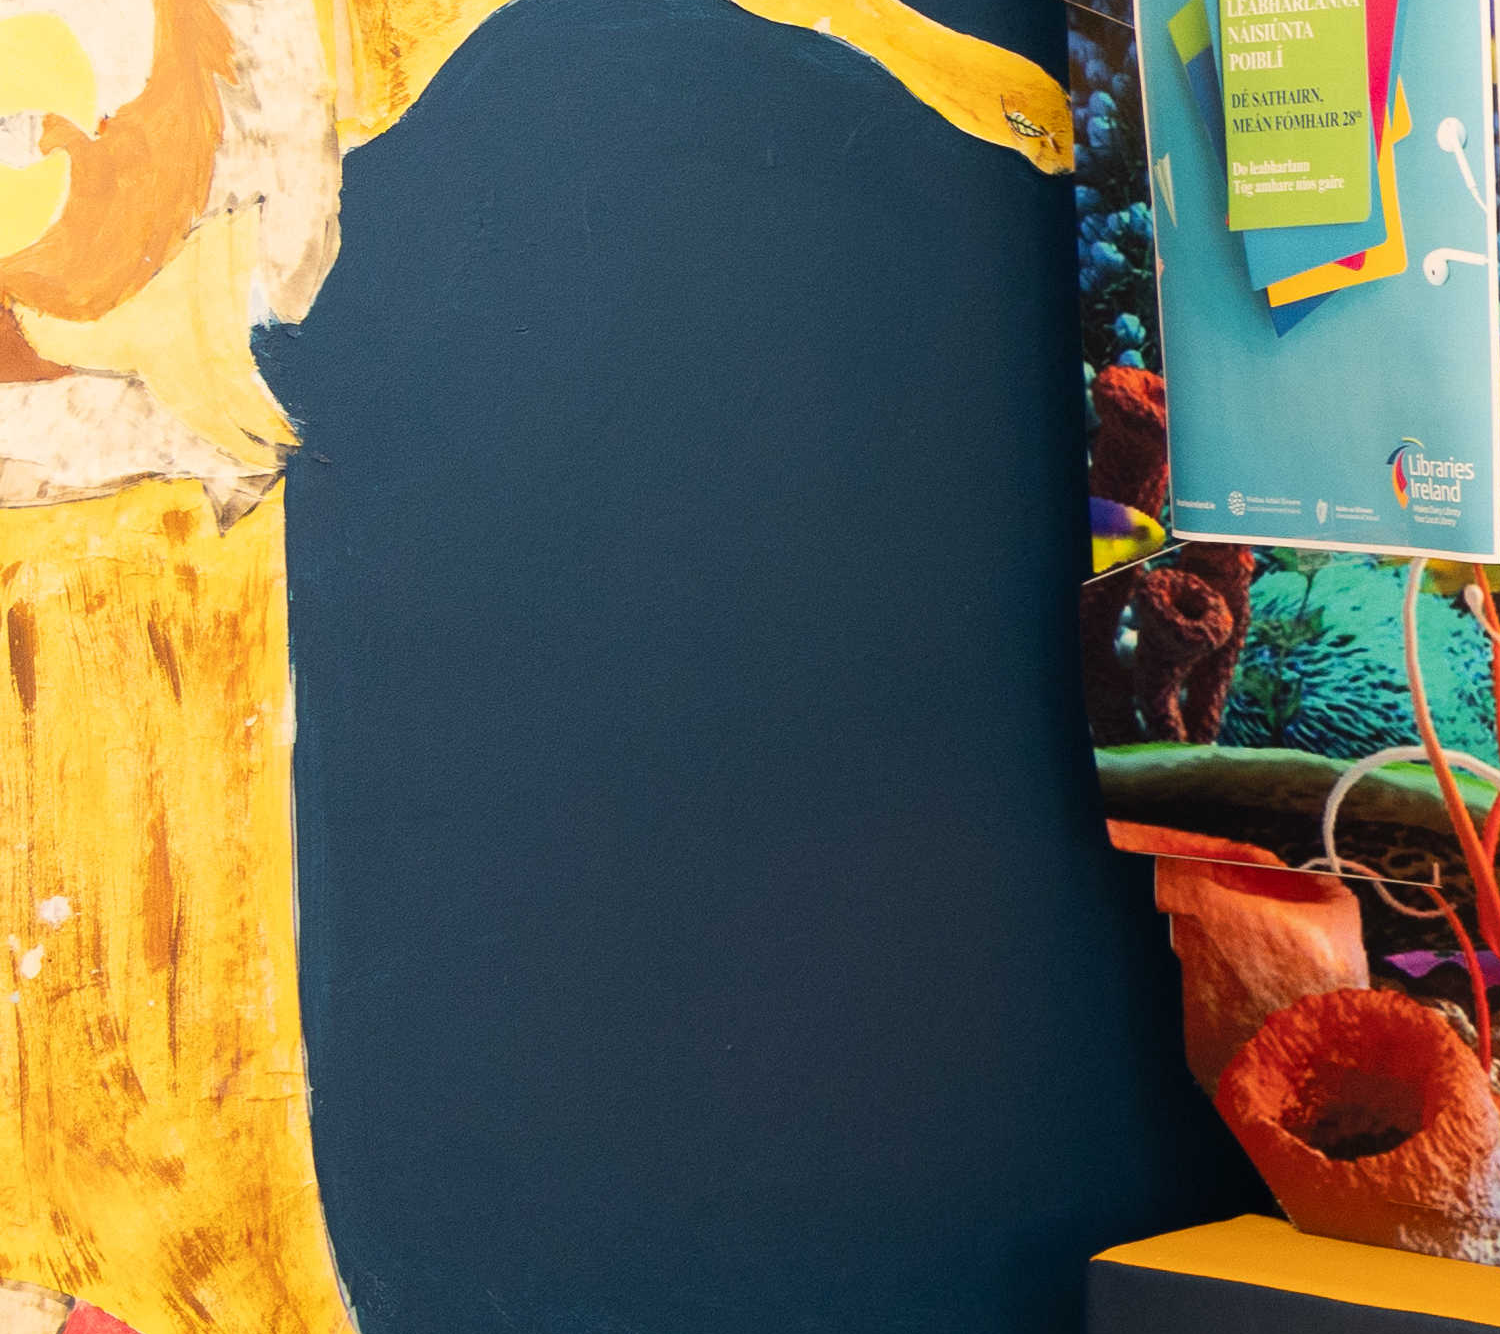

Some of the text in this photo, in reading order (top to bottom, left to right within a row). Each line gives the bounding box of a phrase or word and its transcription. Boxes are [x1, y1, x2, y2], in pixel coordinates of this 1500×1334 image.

[1227, 17, 1314, 45] NÁISIÚNTA
[1229, 44, 1284, 72] POIBLÍ
[1231, 88, 1250, 108] DÉ
[1232, 113, 1272, 134] MEÁN
[1275, 110, 1339, 131] FÓMHAIR
[1407, 453, 1475, 481] Libraries
[1410, 478, 1462, 504] Ireland
